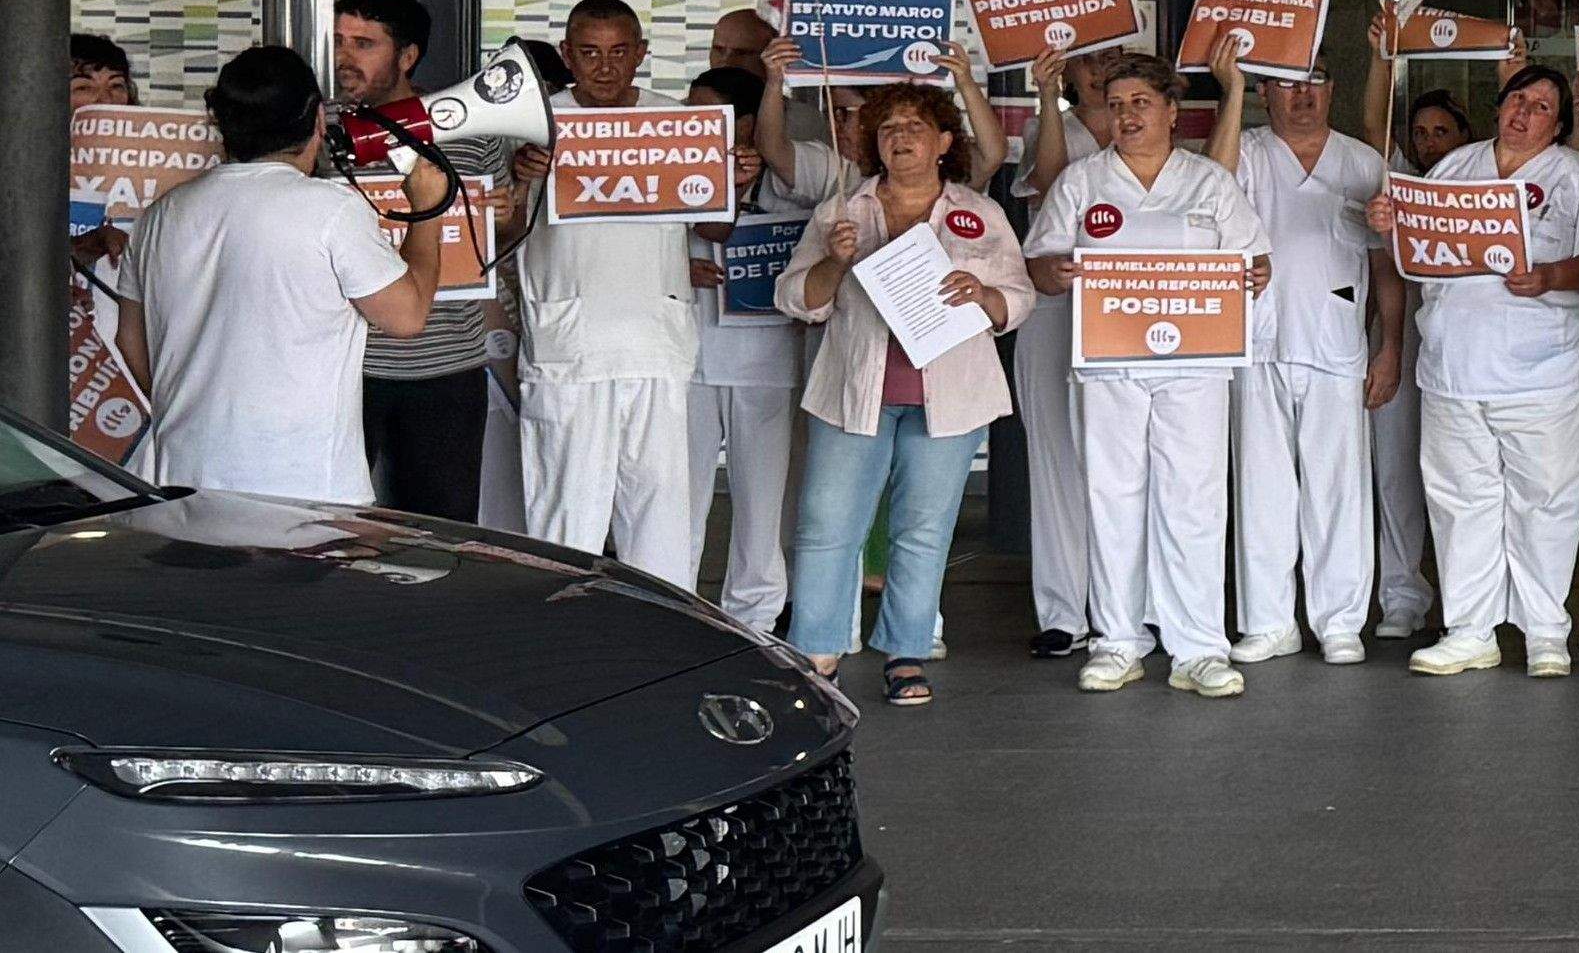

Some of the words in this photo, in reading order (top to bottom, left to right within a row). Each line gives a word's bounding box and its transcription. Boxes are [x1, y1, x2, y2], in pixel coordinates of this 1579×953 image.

[879, 6, 944, 18] MARCO
[1196, 6, 1295, 28] POSIBLE
[791, 22, 824, 36] DE
[832, 23, 943, 40] FUTURO!
[556, 115, 721, 139] XUBILACIÓN
[557, 147, 723, 167] ANTICIPADA
[575, 175, 659, 203] XA!
[1391, 184, 1515, 209] XUBILACIÓN
[1397, 210, 1519, 234] ANTICIPADA
[1408, 237, 1472, 266] XA!
[729, 264, 762, 280] DE
[1084, 261, 1113, 271] SEN
[1115, 261, 1196, 272] MELLORAS
[1198, 262, 1241, 272] REAIS
[1085, 279, 1122, 290] NON
[1126, 279, 1155, 290] HAI
[1158, 279, 1239, 291] REFORMA
[1102, 298, 1222, 315] POSIBLE
